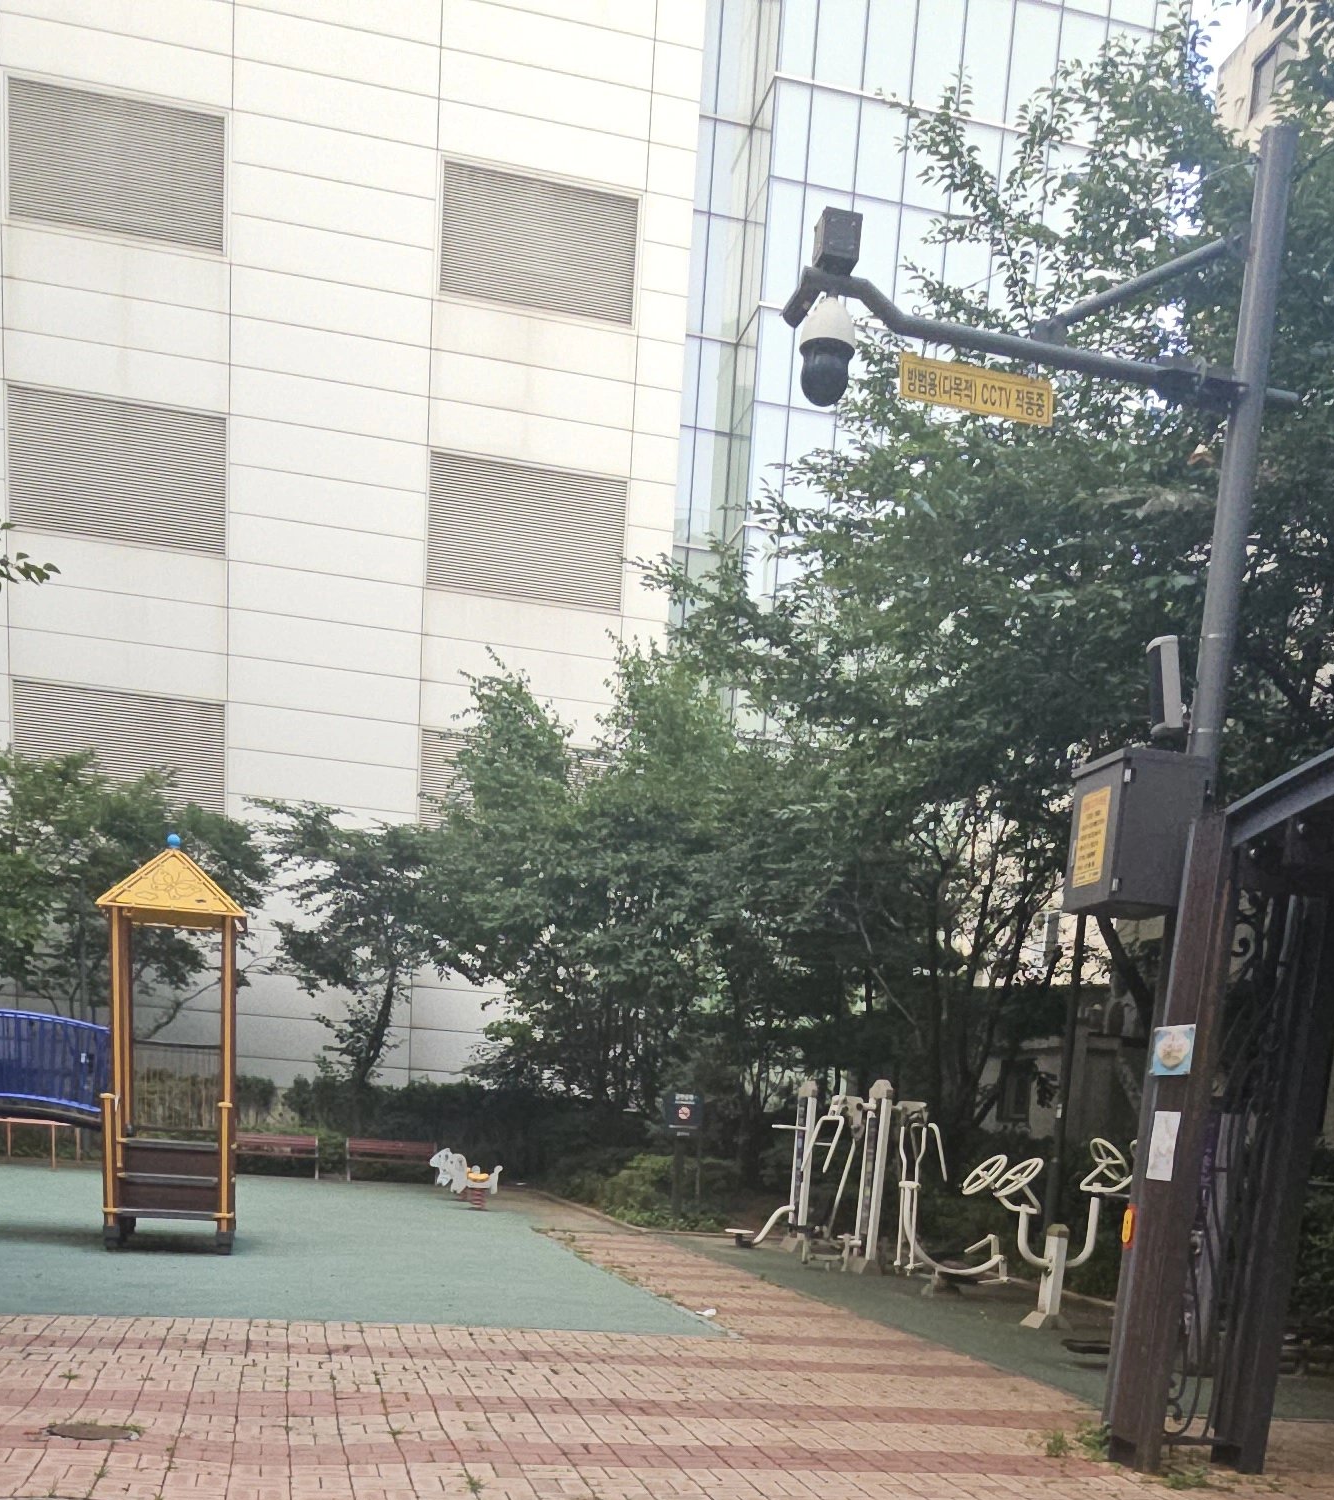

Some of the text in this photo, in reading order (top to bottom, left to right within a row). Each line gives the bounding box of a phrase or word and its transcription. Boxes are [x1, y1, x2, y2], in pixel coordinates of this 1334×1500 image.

[907, 367, 1045, 418] 방범용(다목적) CCTV 작동중
